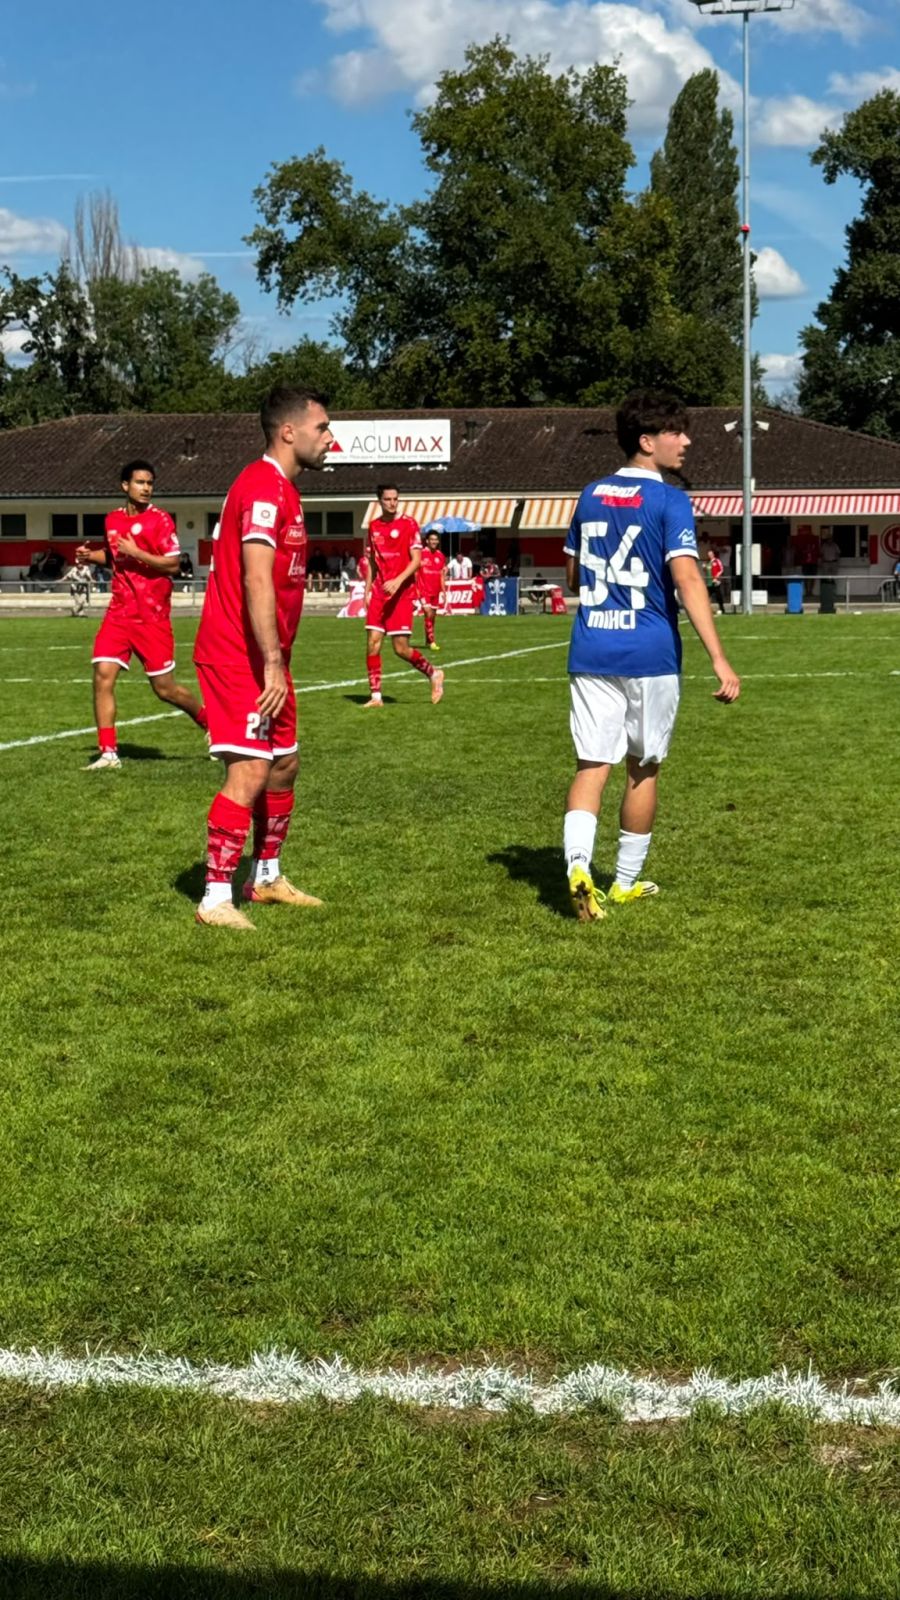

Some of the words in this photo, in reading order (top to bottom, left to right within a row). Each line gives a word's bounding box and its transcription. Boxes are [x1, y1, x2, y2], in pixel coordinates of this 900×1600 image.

[350, 435, 443, 453] ACUMAX
[579, 521, 649, 610] 54
[245, 711, 271, 741] 22
